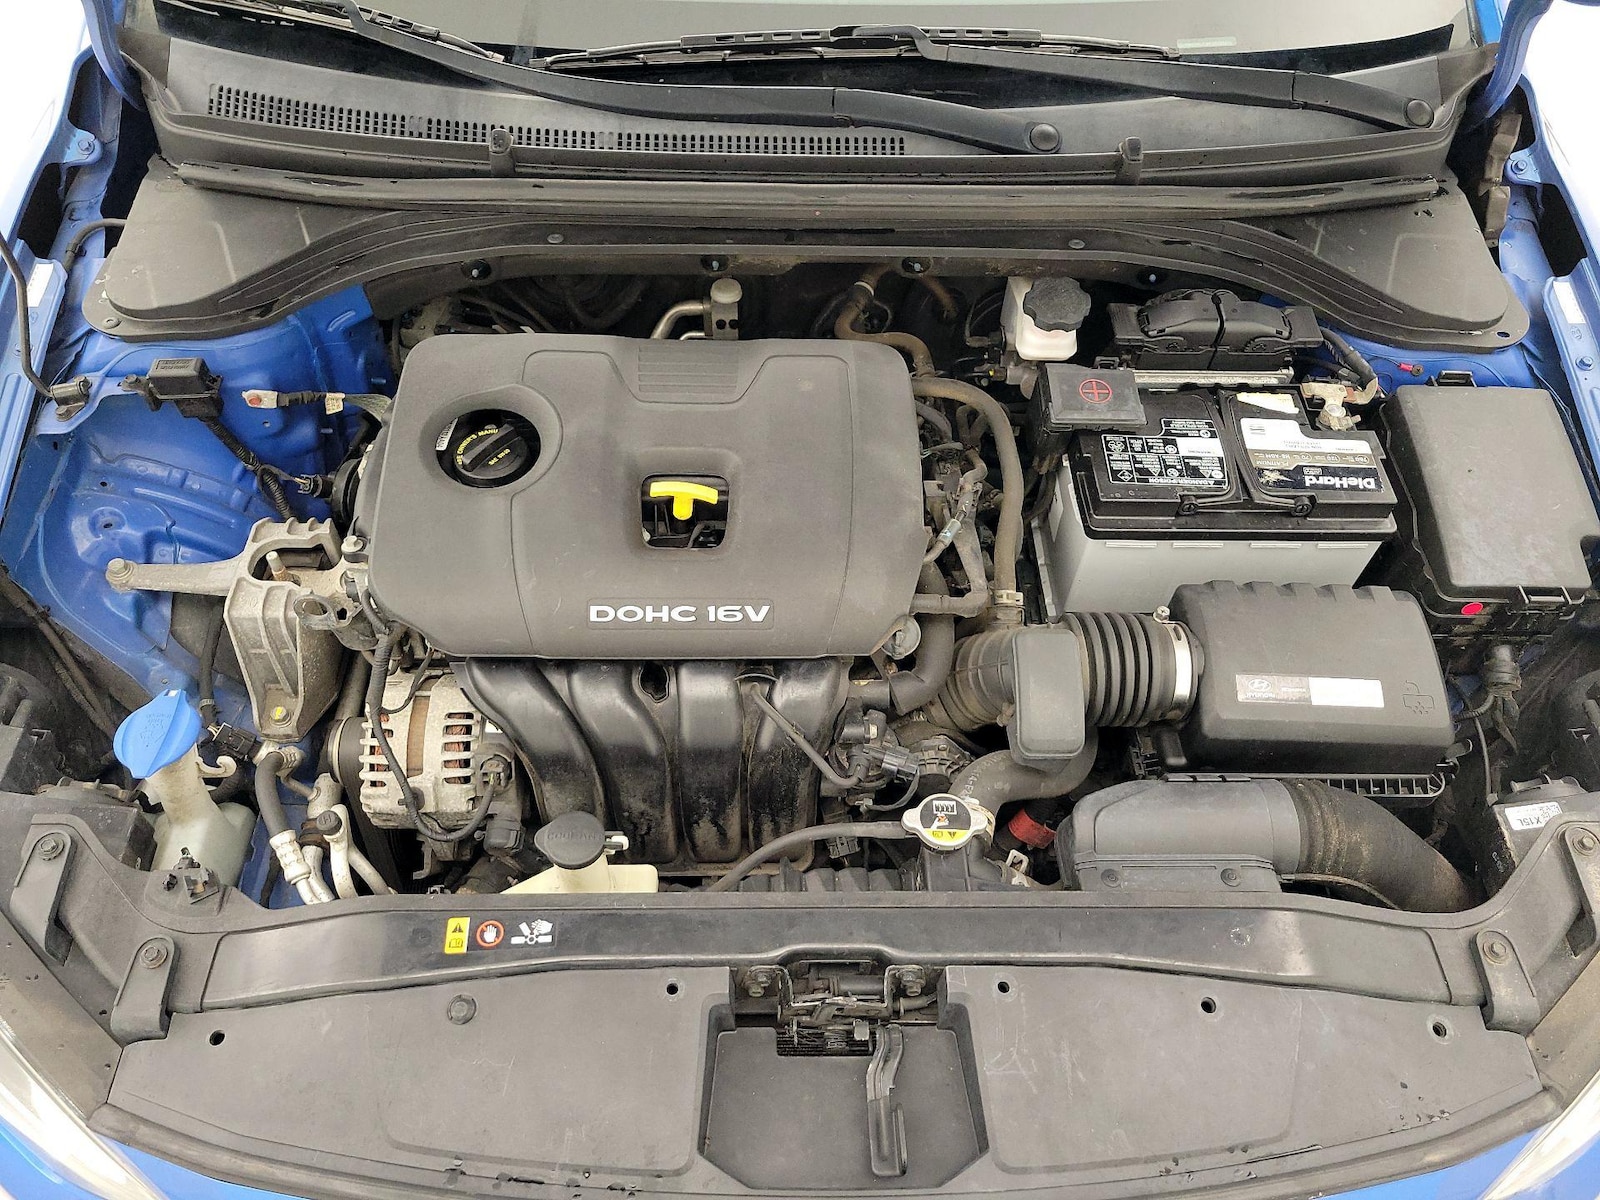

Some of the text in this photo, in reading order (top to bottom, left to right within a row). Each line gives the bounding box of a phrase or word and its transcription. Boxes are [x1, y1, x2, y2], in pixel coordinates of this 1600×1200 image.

[478, 428, 499, 437] MANU
[1303, 475, 1376, 489] DieHard
[589, 605, 770, 622] DOHC 16V
